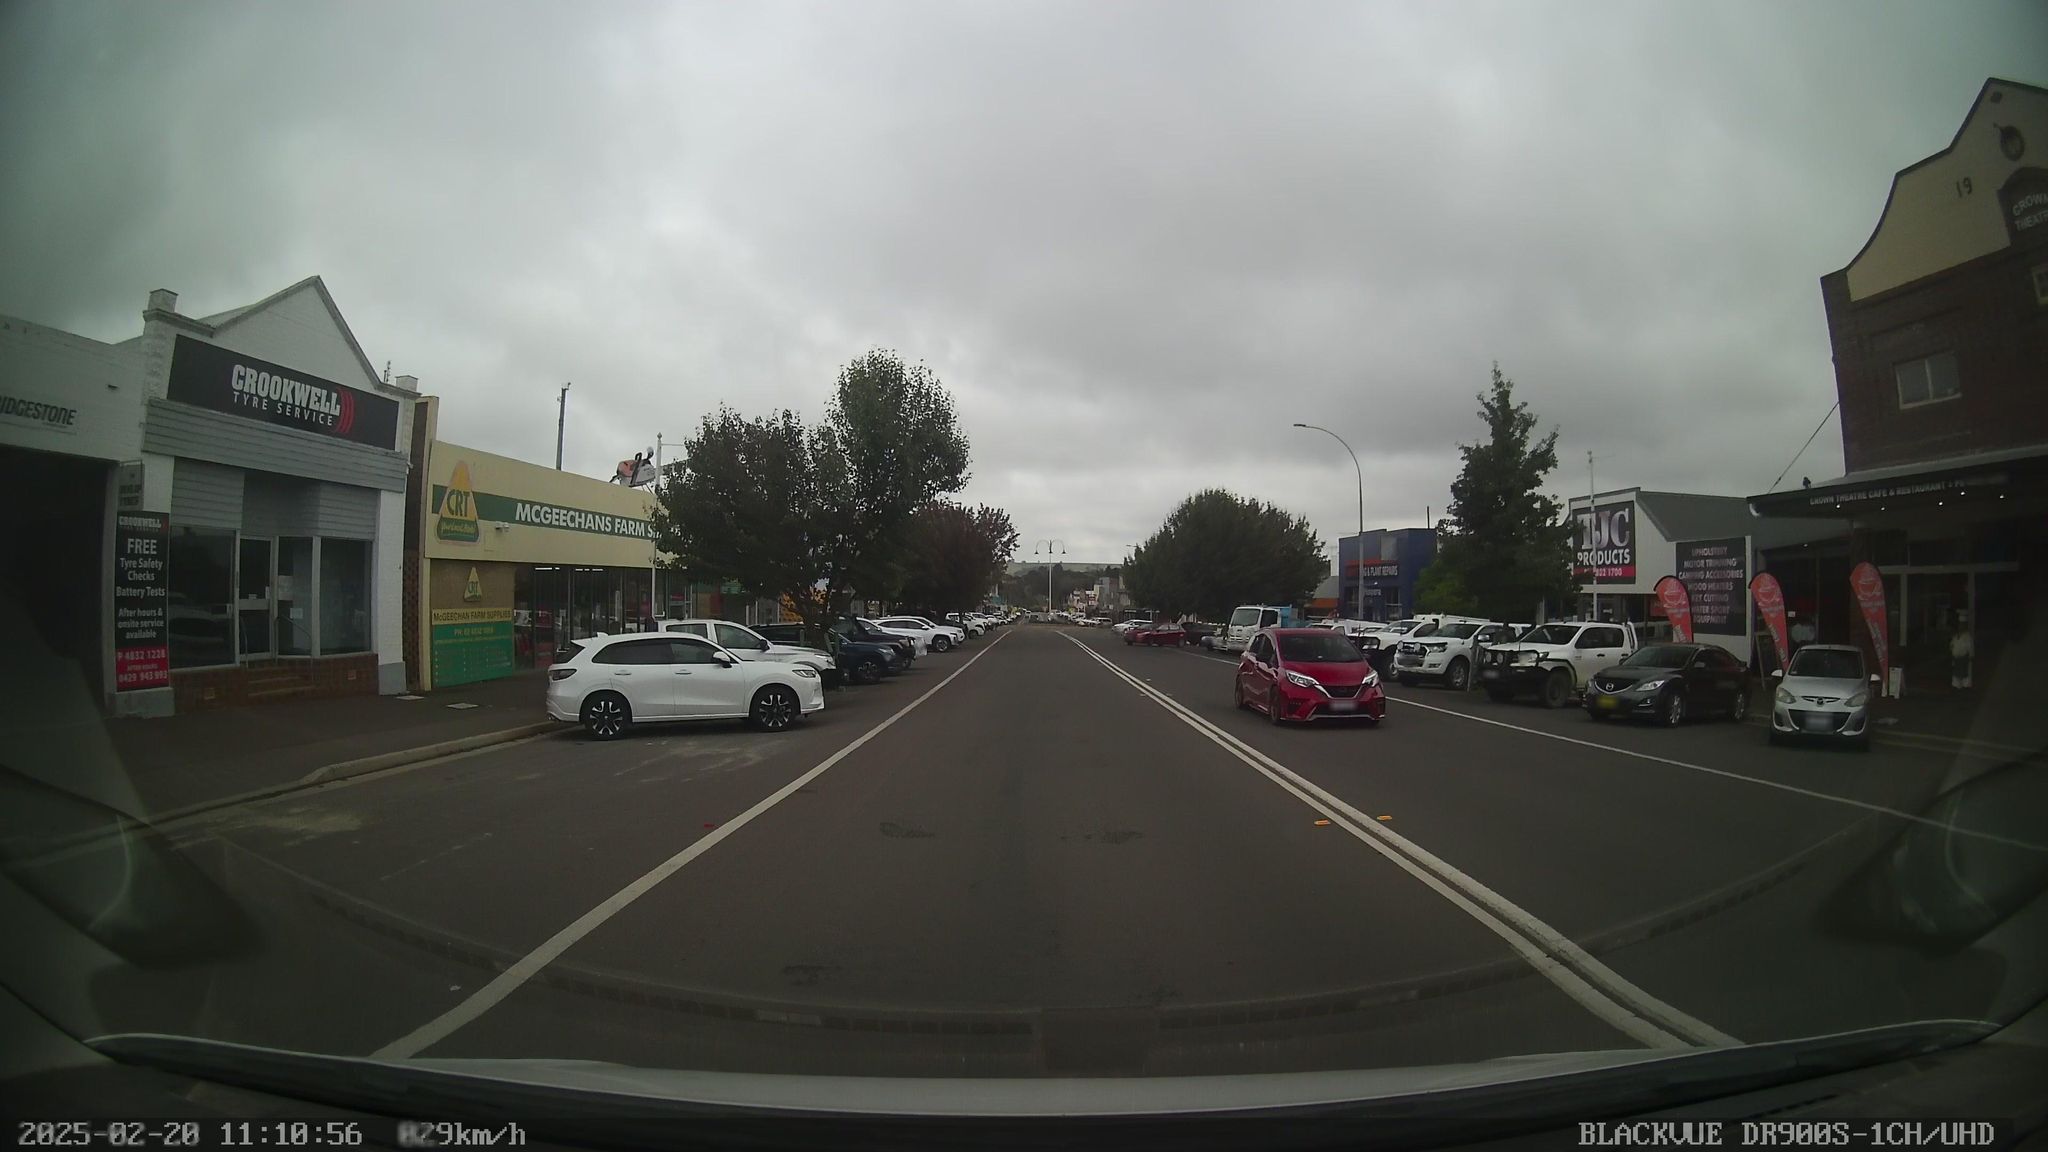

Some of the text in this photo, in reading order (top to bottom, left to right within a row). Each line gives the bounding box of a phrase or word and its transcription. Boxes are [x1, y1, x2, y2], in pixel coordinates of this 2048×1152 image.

[231, 364, 341, 417] CROOKWELL
[233, 391, 333, 427] TYRE SERVICE
[447, 489, 470, 517] CRT
[515, 502, 611, 532] MCGEECHANS
[615, 520, 645, 537] FARM
[1577, 508, 1630, 550] TJC
[127, 538, 157, 554] FREE
[120, 557, 163, 571] Tyre Safety
[1577, 549, 1630, 566] PRODUCTS
[127, 570, 155, 581] Checks
[115, 586, 166, 599] Battery Tests
[467, 581, 479, 594] CRT
[118, 607, 136, 617] After
[137, 608, 157, 617] hours
[433, 611, 470, 621] McGEECHAN
[471, 610, 486, 620] FARM
[140, 618, 164, 628] service
[125, 630, 157, 639] available
